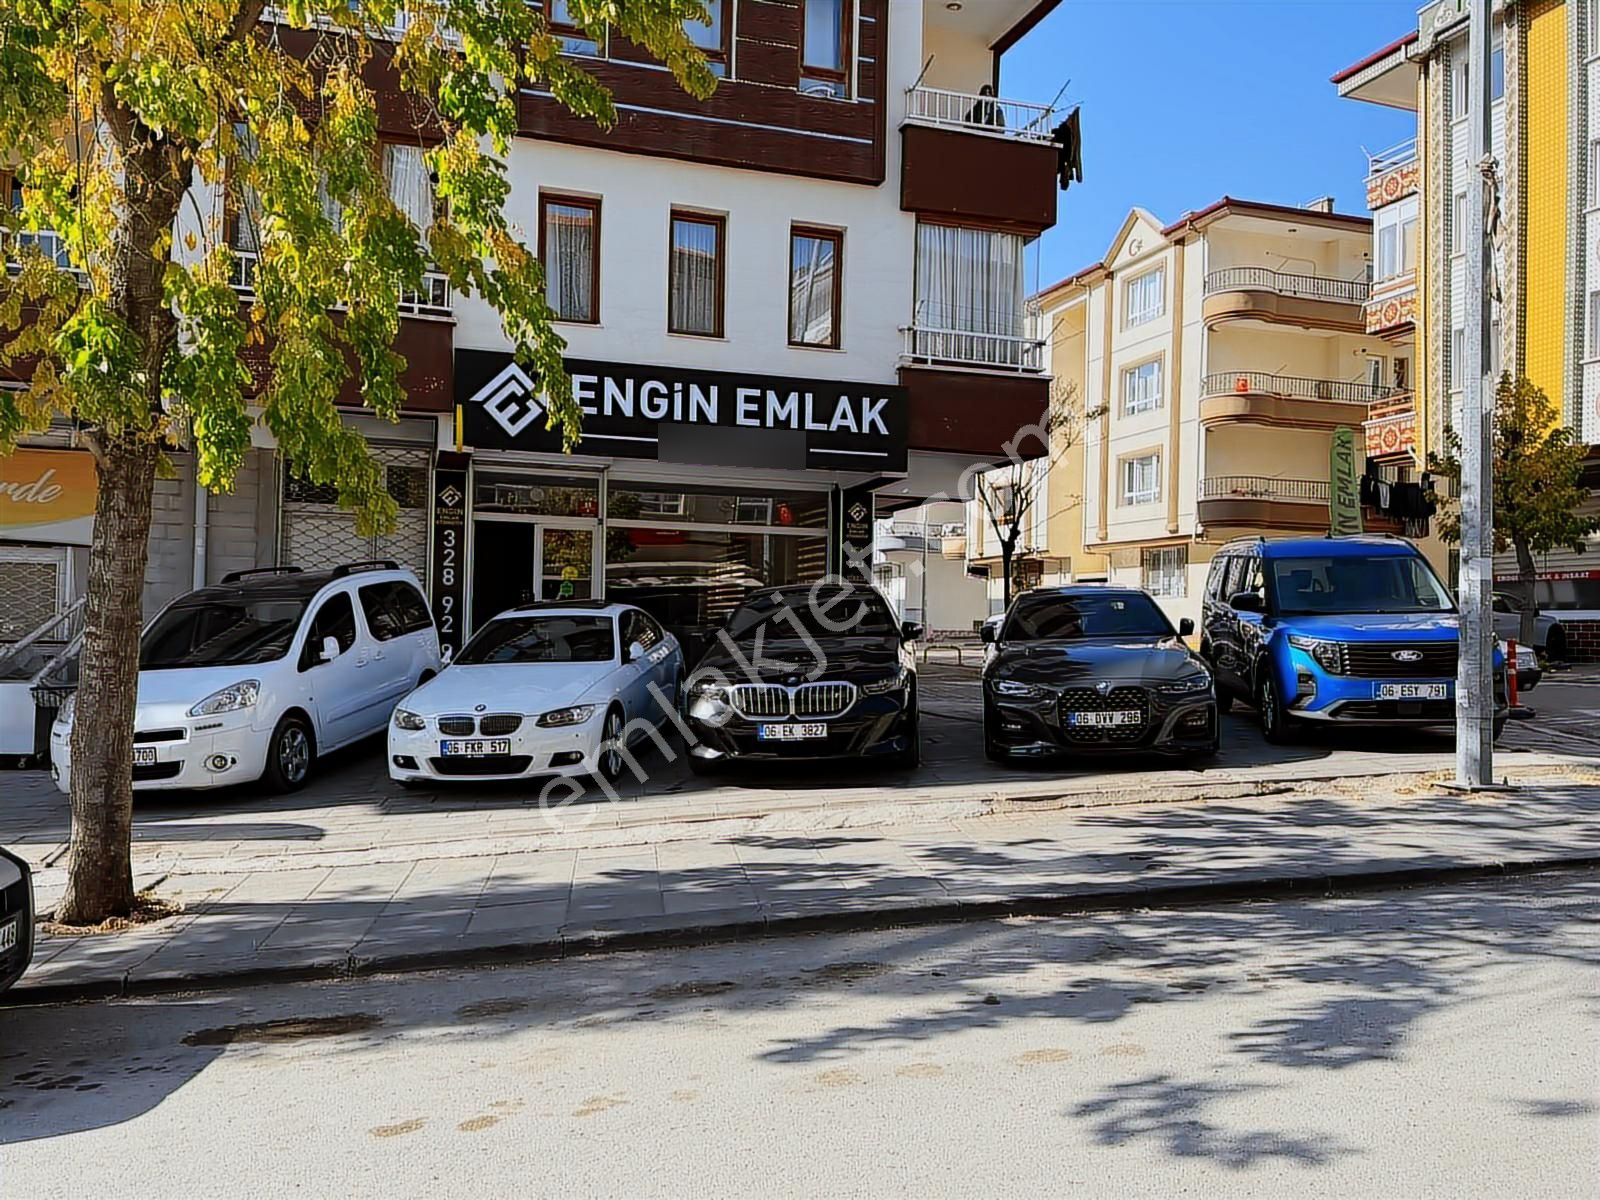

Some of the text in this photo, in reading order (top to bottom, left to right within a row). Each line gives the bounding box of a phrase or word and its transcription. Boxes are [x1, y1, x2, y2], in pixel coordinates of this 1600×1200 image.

[736, 388, 889, 435] EMLAK
[1336, 432, 1356, 508] EMLAK
[1382, 685, 1445, 698] 06 ESY 791
[1076, 713, 1090, 725] 06
[764, 724, 825, 737] 06 EK 3827
[447, 741, 508, 754] 06 FKR 517
